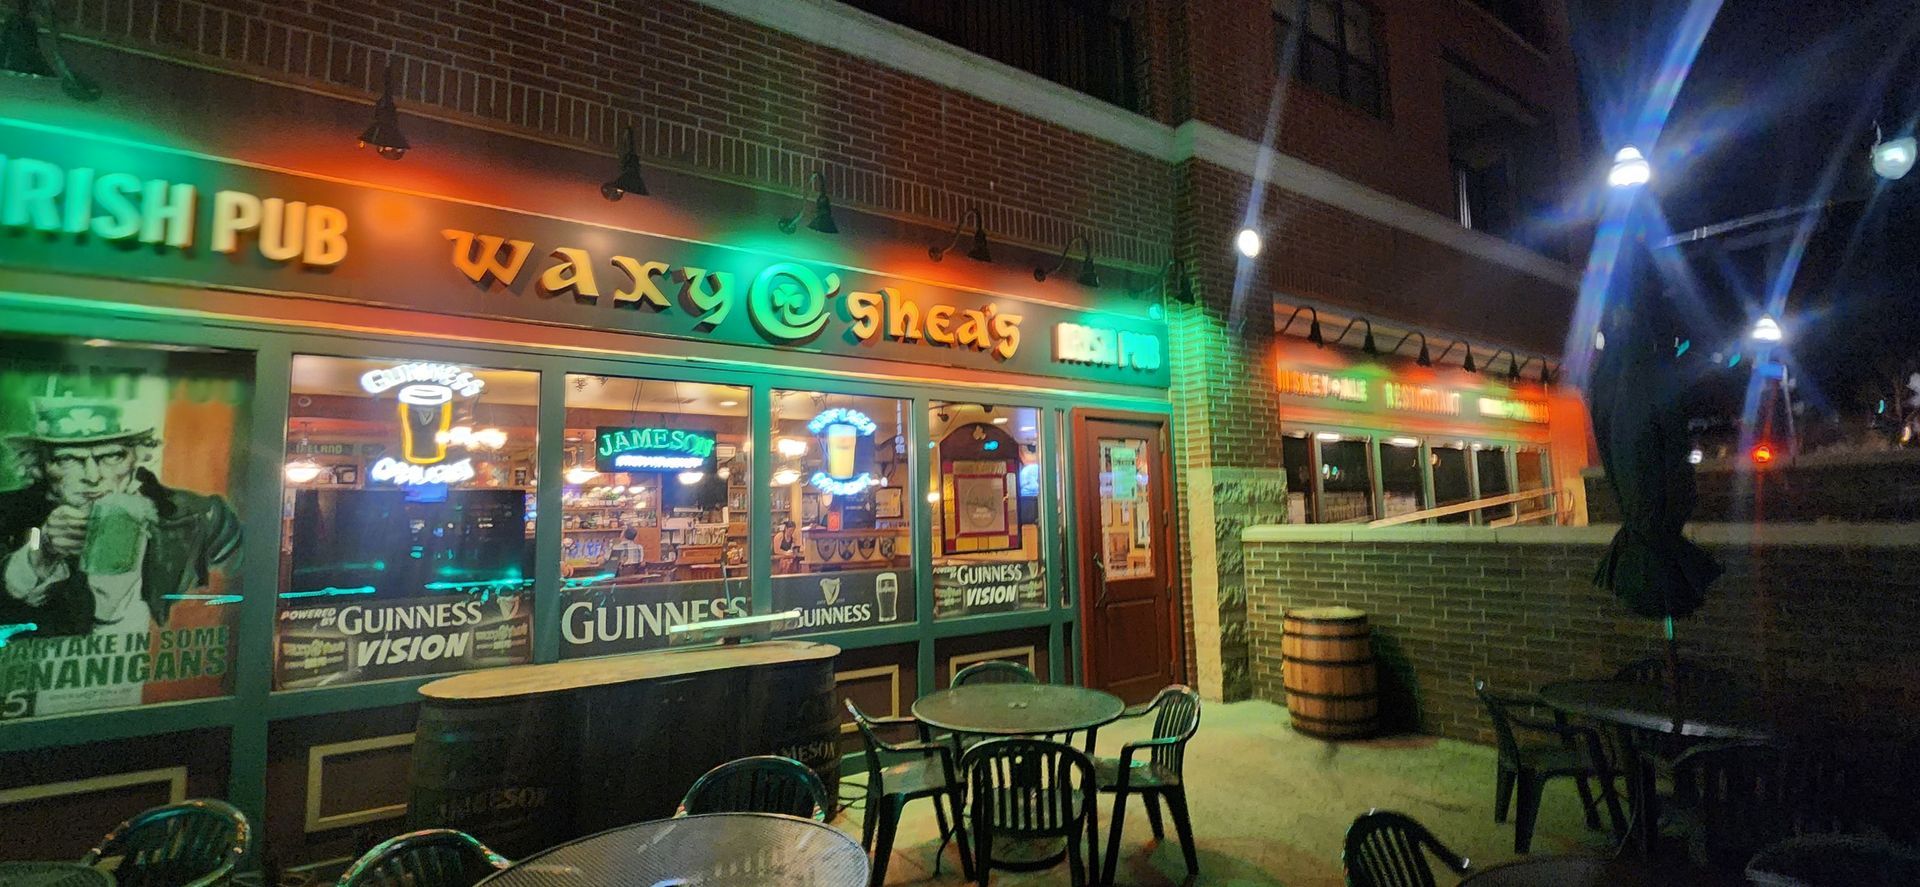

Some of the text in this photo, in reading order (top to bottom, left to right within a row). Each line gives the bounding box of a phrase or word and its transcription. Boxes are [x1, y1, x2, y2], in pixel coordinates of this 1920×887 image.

[0, 150, 348, 265] RISH PUB
[599, 428, 715, 458] JAMESON
[957, 564, 1022, 586] GUINNESS
[966, 585, 1018, 607] VISION
[280, 607, 337, 620] POWERED
[337, 601, 483, 635] GUINNESS
[561, 596, 748, 645] GUINNESS
[126, 632, 150, 652] IN
[160, 625, 230, 651] SOME
[357, 631, 469, 667] VISION
